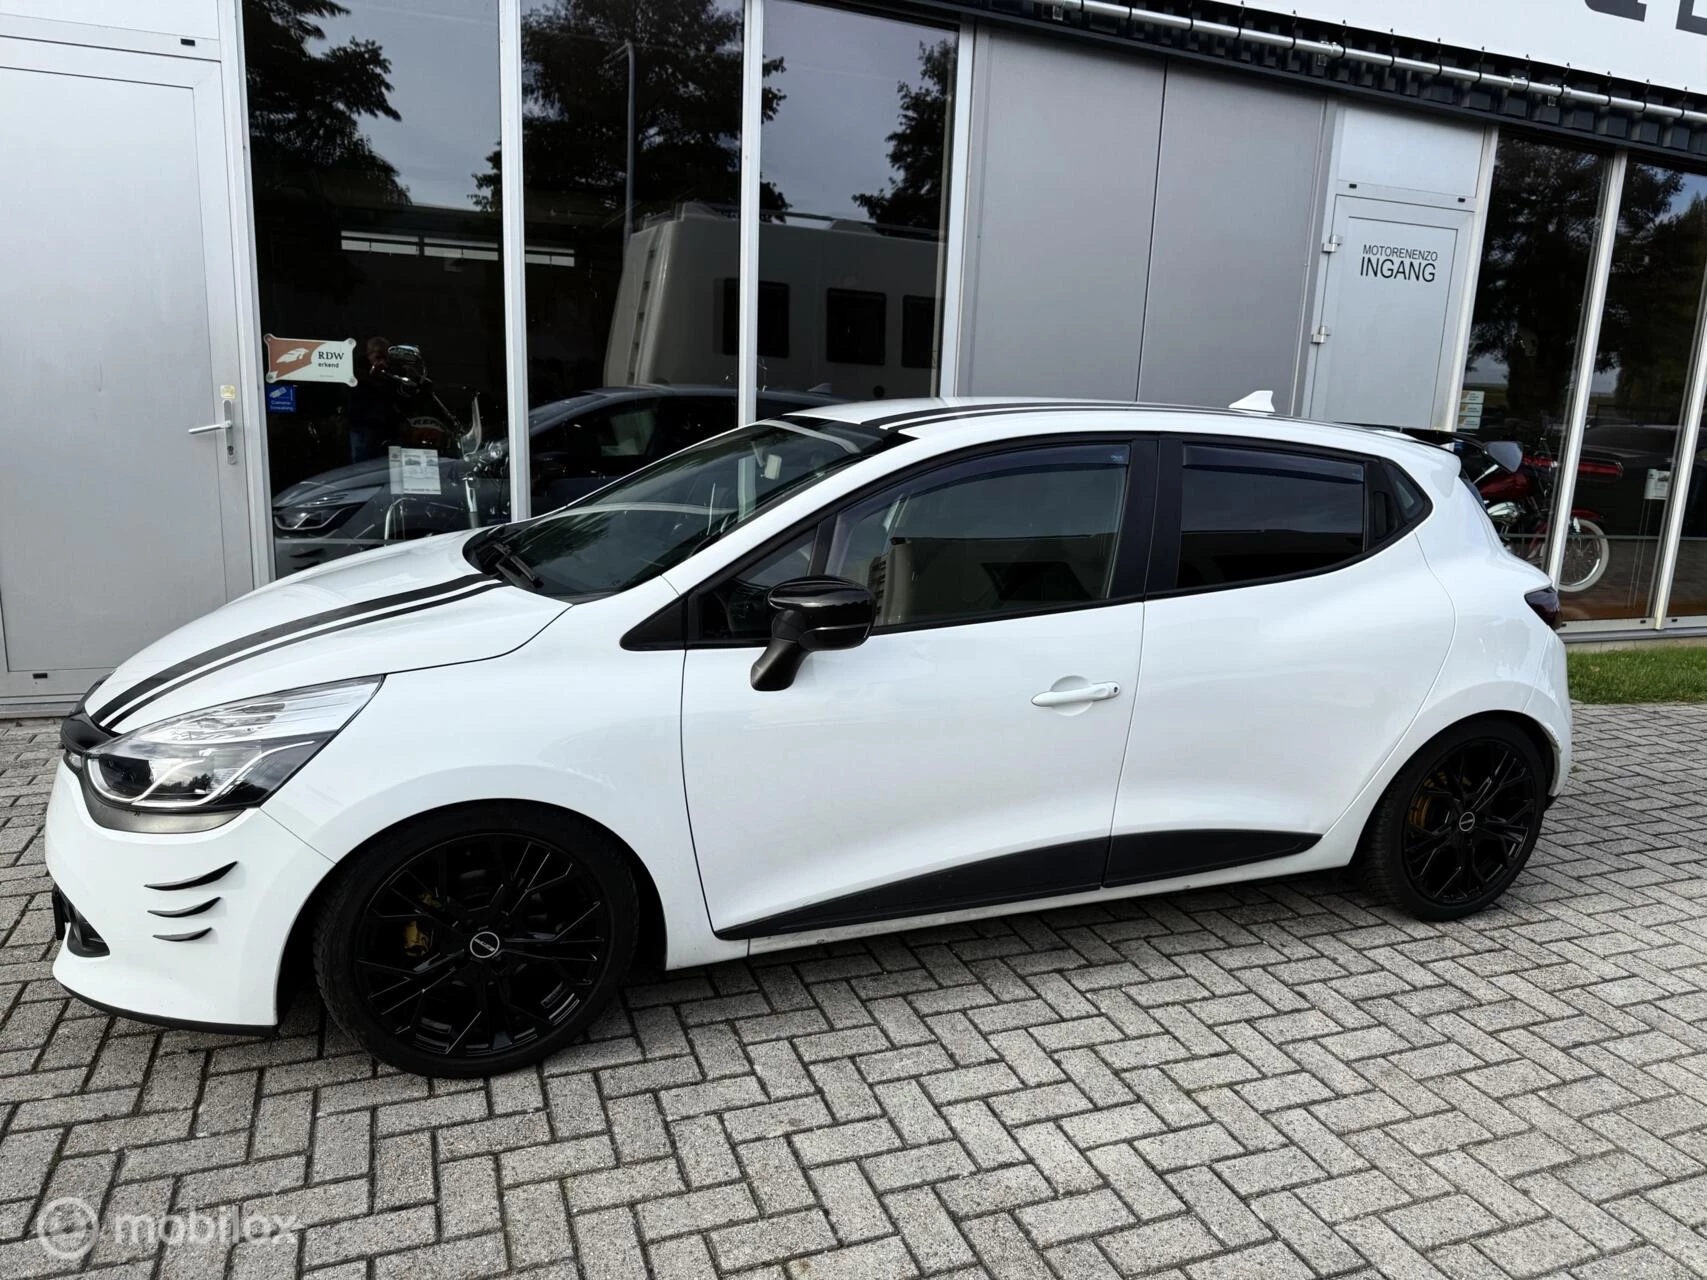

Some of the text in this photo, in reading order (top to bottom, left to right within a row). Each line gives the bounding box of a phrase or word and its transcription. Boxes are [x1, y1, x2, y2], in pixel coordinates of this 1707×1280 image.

[1362, 244, 1439, 262] MOTORENENZO
[1360, 256, 1436, 282] INGANG
[318, 351, 345, 360] RDW
